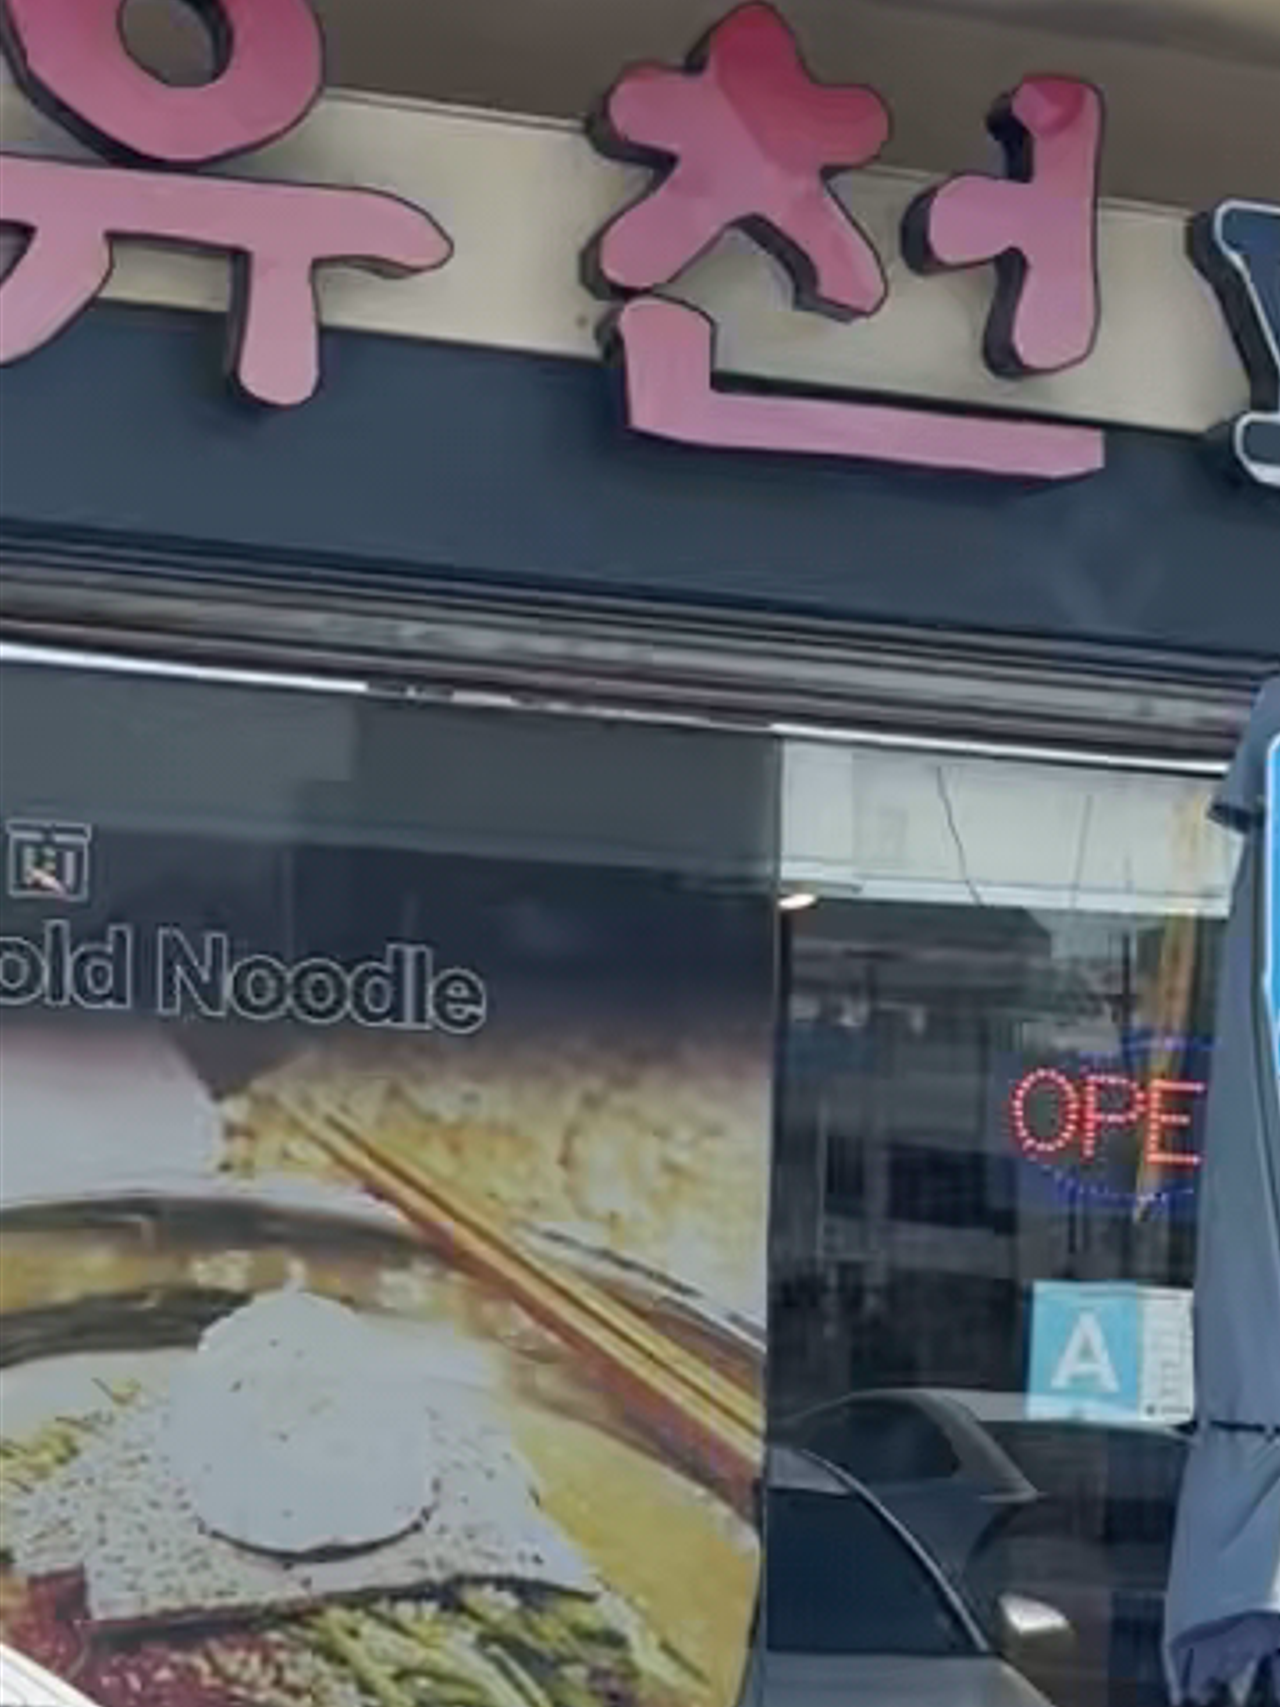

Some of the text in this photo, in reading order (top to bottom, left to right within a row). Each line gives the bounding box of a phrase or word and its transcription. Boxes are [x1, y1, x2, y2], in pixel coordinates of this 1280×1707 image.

[0, 919, 487, 1033] old Noodle
[1011, 1069, 1207, 1165] OPE
[1051, 1312, 1121, 1393] A
